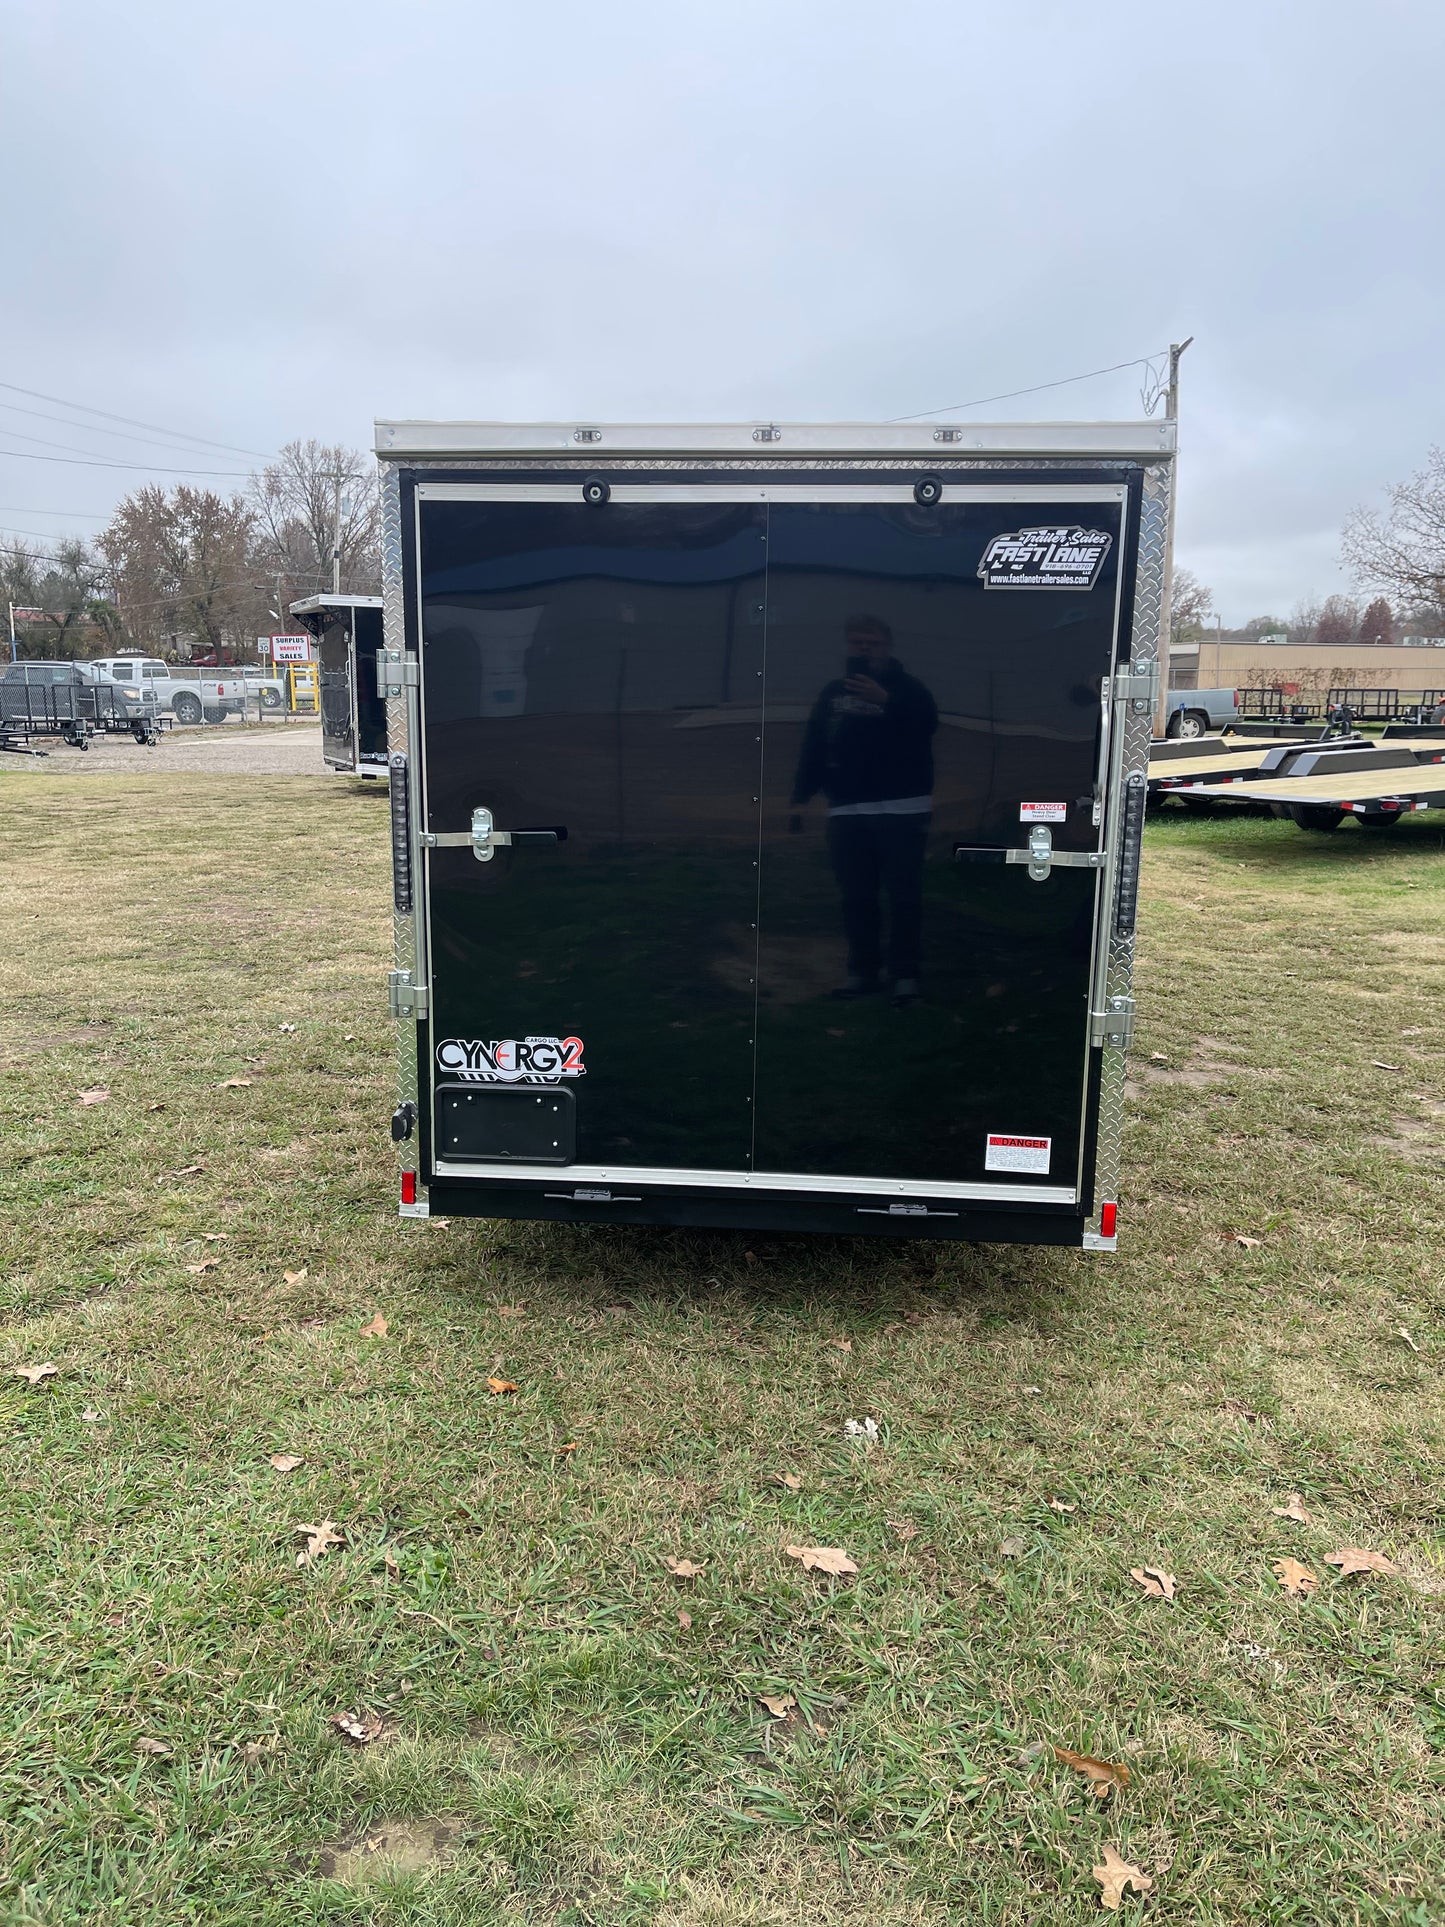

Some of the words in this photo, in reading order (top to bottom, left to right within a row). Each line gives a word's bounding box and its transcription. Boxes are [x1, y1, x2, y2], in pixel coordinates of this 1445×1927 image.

[1023, 530, 1068, 545] Trailer
[1069, 531, 1108, 545] Sales
[990, 573, 1089, 584] www.fastlanetrailersales.com
[1002, 1138, 1047, 1149] DANGER
